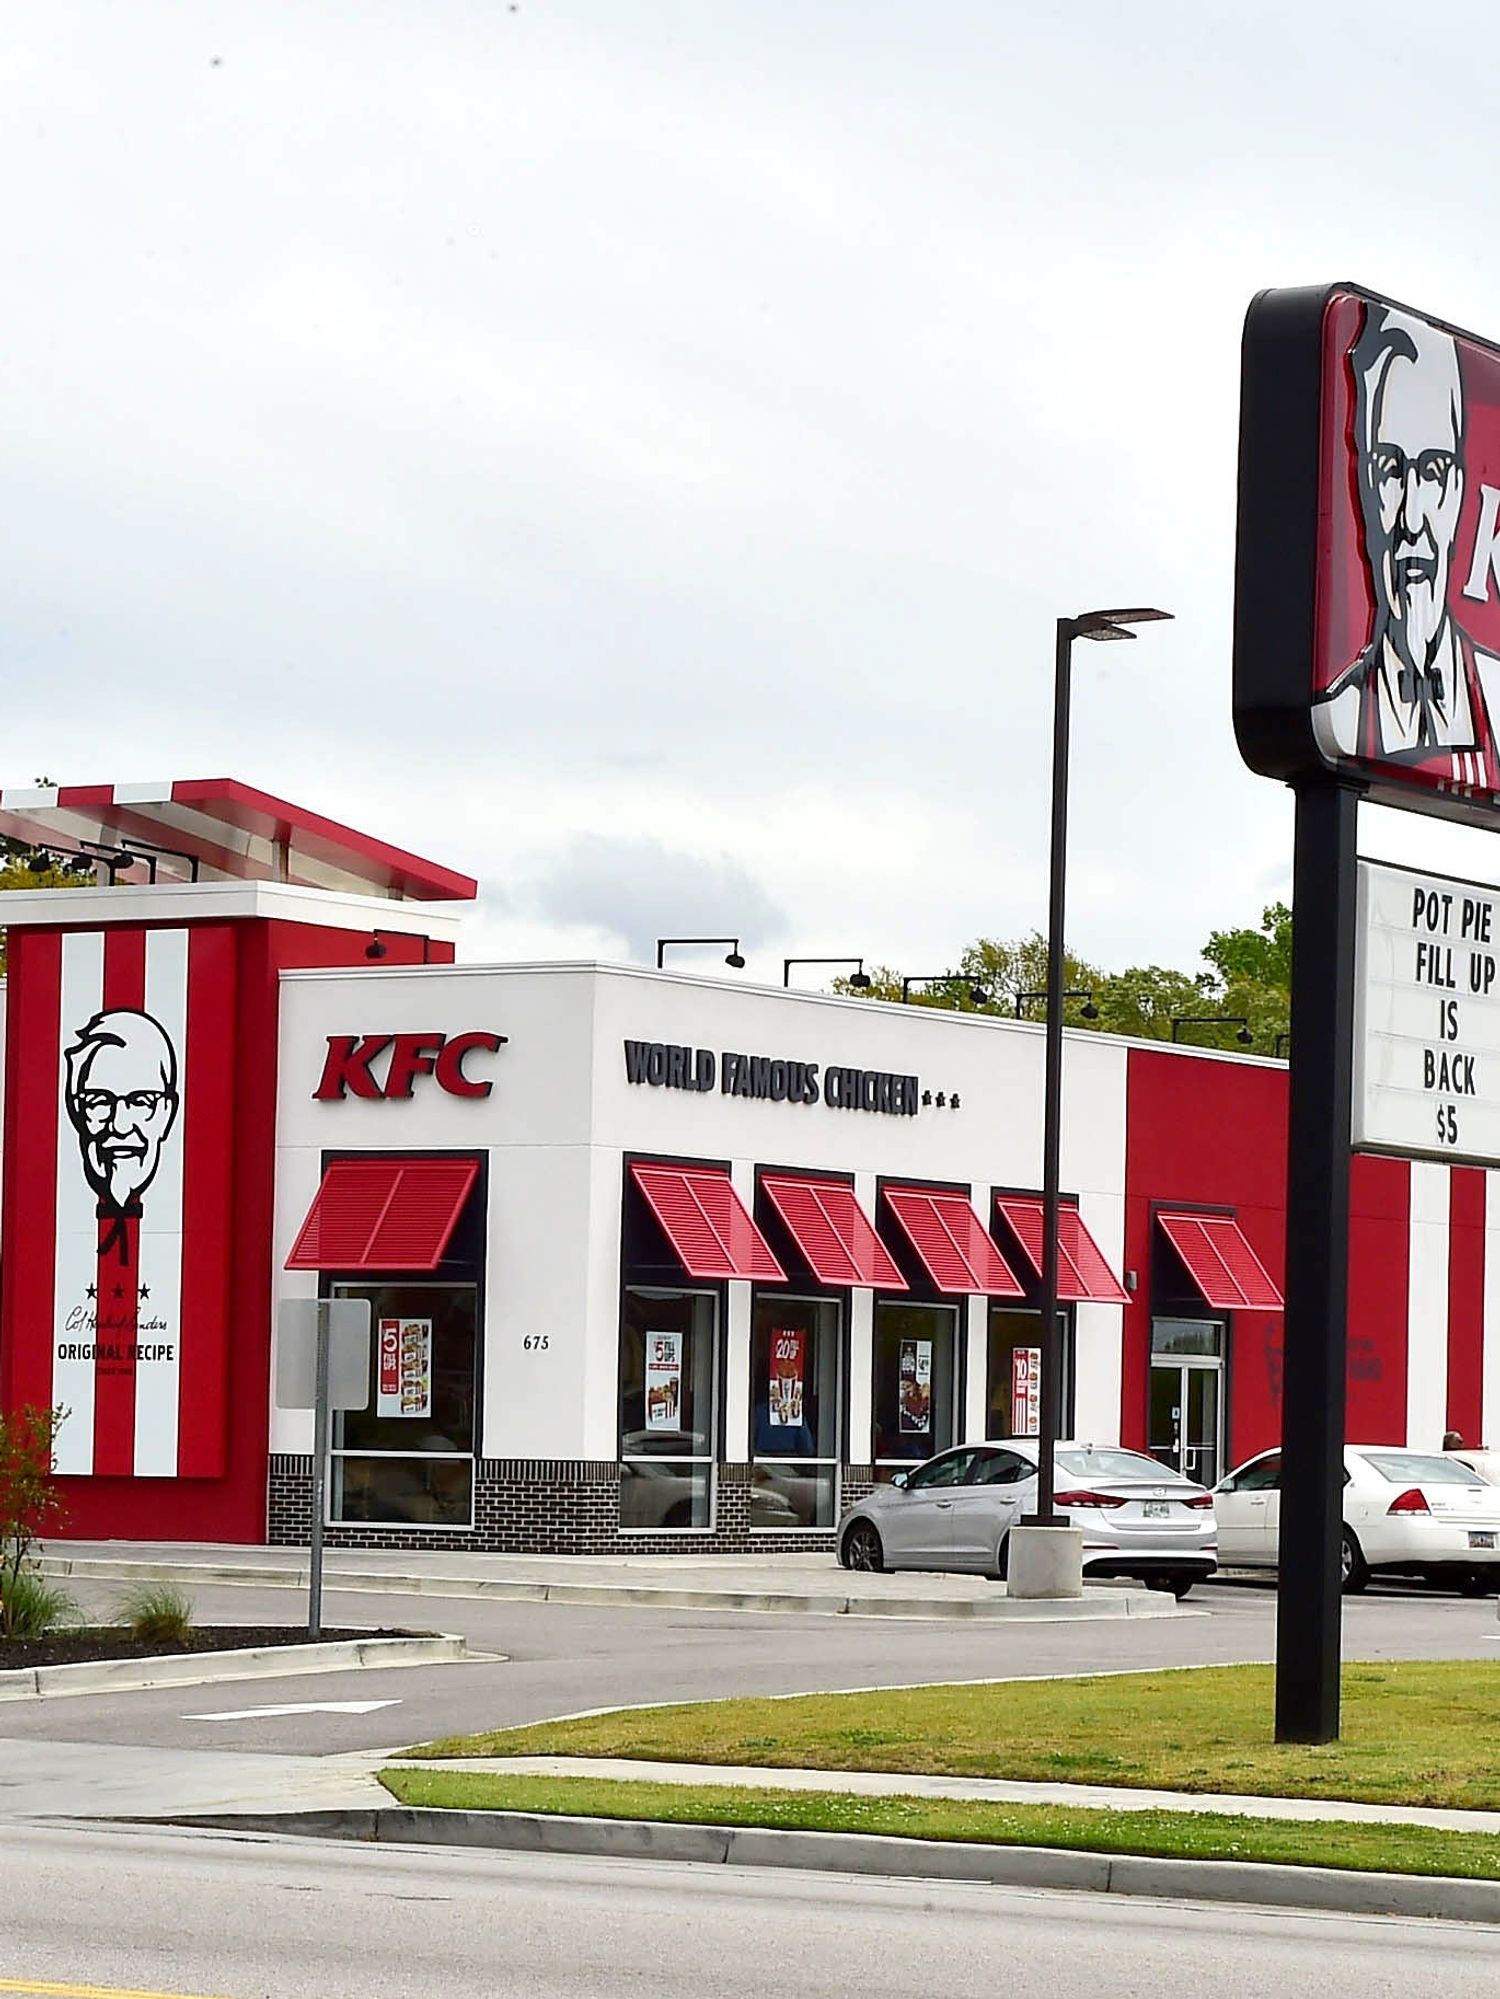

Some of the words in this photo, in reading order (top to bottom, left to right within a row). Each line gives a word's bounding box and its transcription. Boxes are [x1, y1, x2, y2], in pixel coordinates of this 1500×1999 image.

[1412, 887, 1453, 935] POT
[1461, 898, 1492, 943] PIE
[1416, 942, 1456, 989] FILL
[1470, 952, 1496, 994] UP
[1440, 999, 1458, 1041] IS
[311, 1031, 509, 1100] KFC
[624, 1039, 716, 1092] WORLD
[721, 1052, 819, 1104] FAMOUS
[824, 1066, 918, 1116] CHICKEN
[1424, 1049, 1476, 1095] BACK
[1437, 1104, 1458, 1144] $5
[57, 1344, 122, 1361] ORIGINAL
[128, 1344, 175, 1361] RECIPE
[523, 1334, 549, 1350] 675
